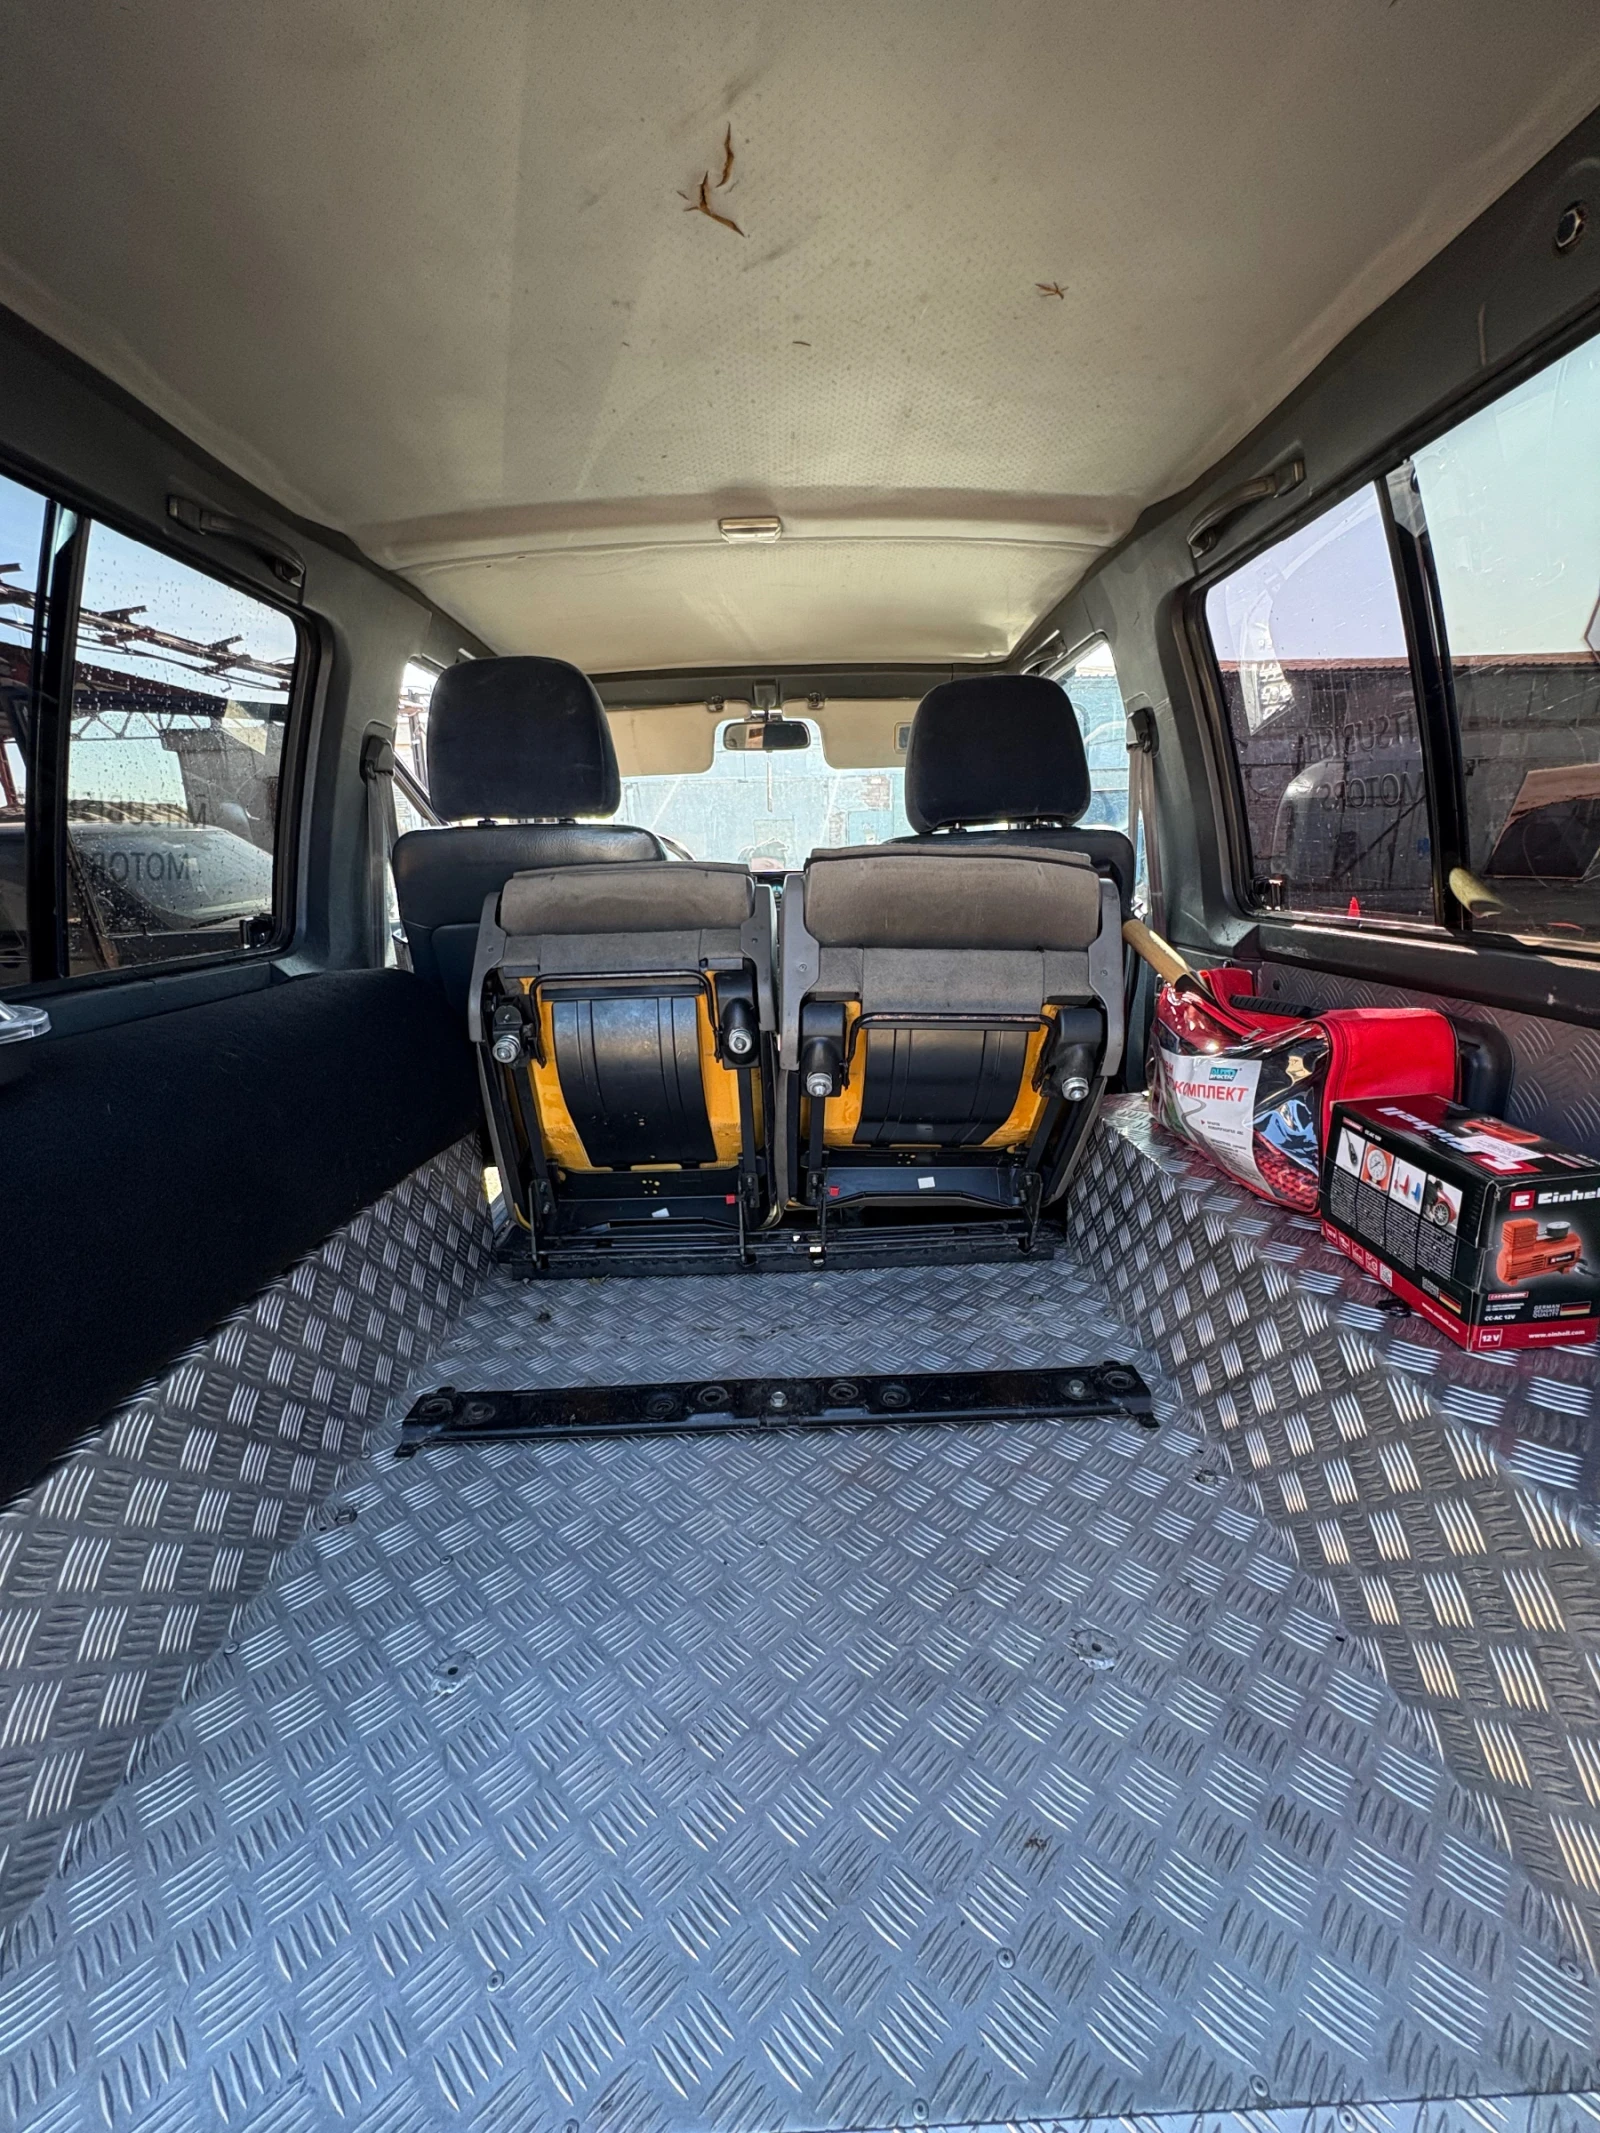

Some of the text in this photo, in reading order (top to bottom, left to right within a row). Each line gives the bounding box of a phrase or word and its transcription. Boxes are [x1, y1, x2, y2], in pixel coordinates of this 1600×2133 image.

[1482, 1334, 1500, 1342] 12 V
[1528, 1330, 1586, 1339] www.einhell.com
